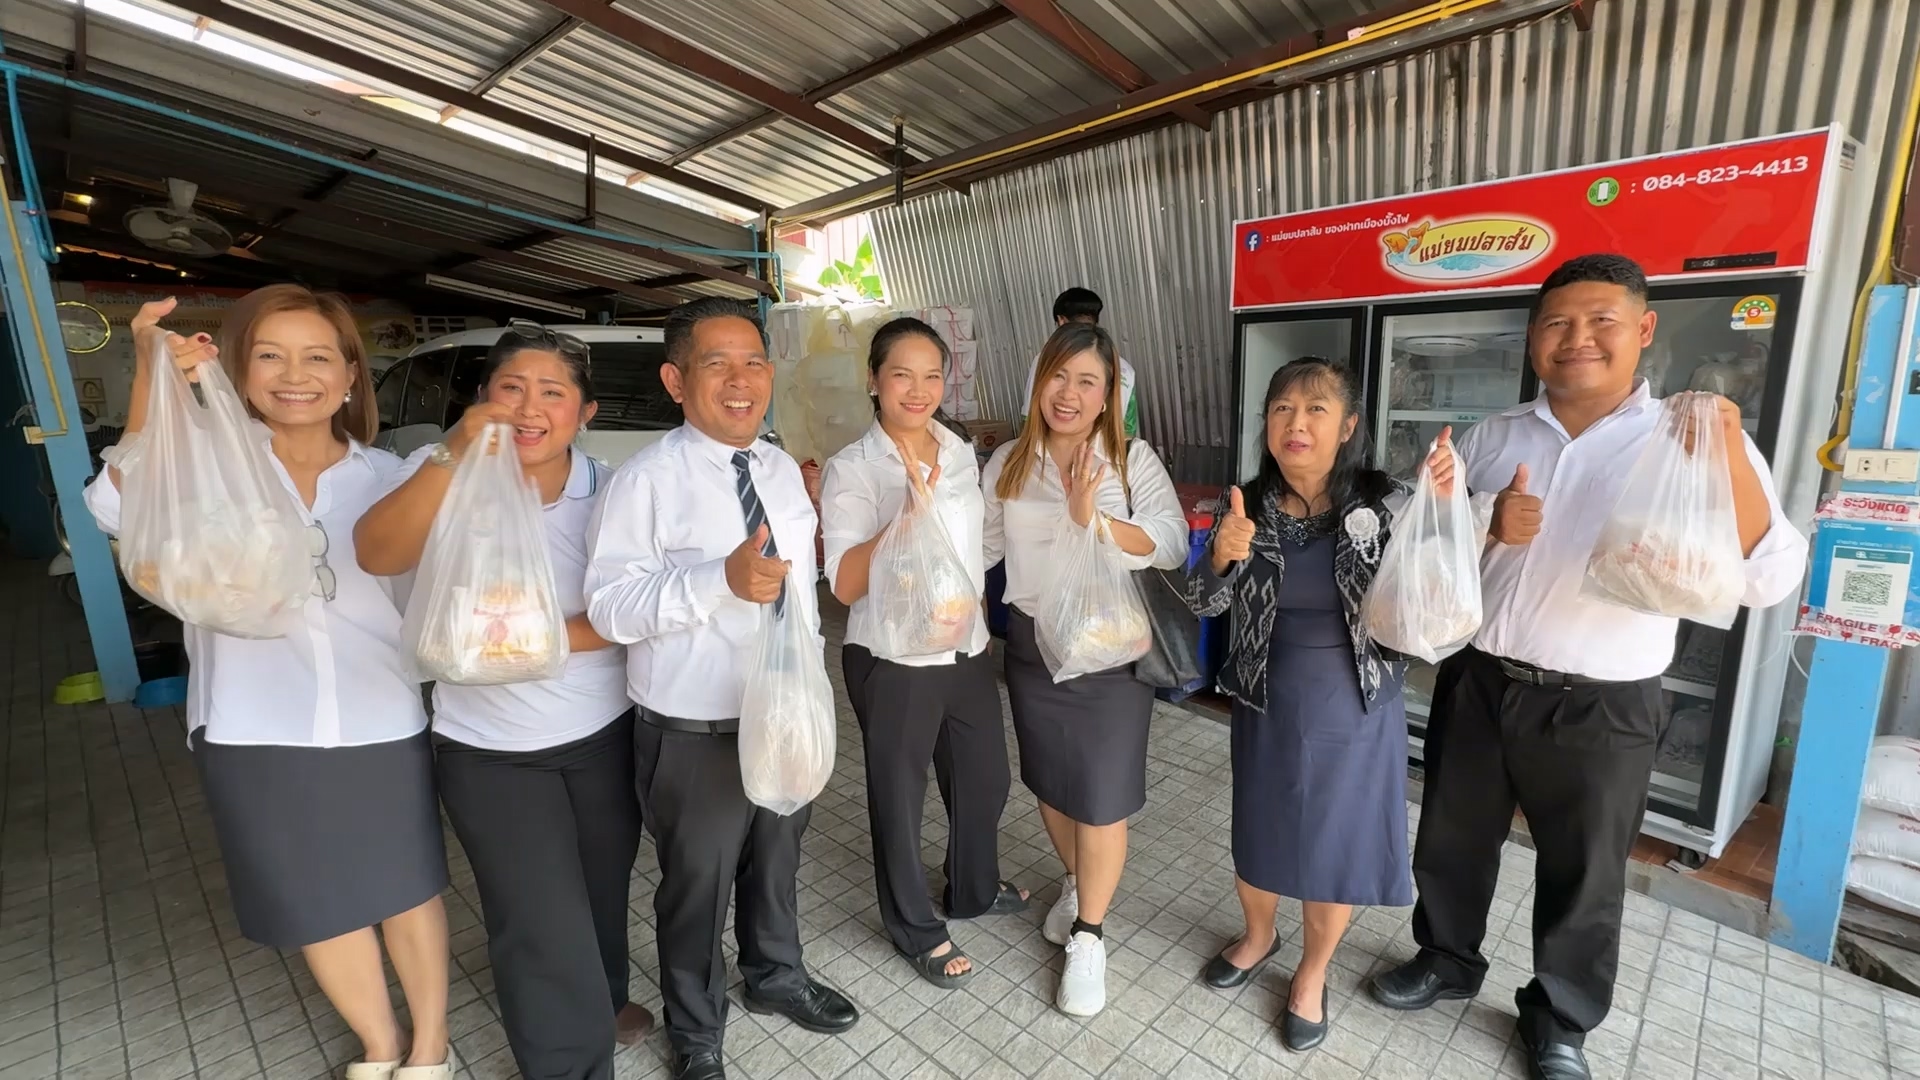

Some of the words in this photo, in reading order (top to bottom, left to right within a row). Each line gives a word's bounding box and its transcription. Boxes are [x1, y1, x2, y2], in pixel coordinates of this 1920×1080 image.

[1643, 156, 1809, 192] 084-823-4413
[1271, 226, 1322, 242] แม่ยมปลาส้ม
[1325, 212, 1410, 235] ของฝากเมืองบั้งไฟ
[1419, 227, 1536, 263] แม่ยมปลาส้ม
[1843, 497, 1910, 515] ระวังแตก
[1816, 612, 1879, 633] FRAGILE
